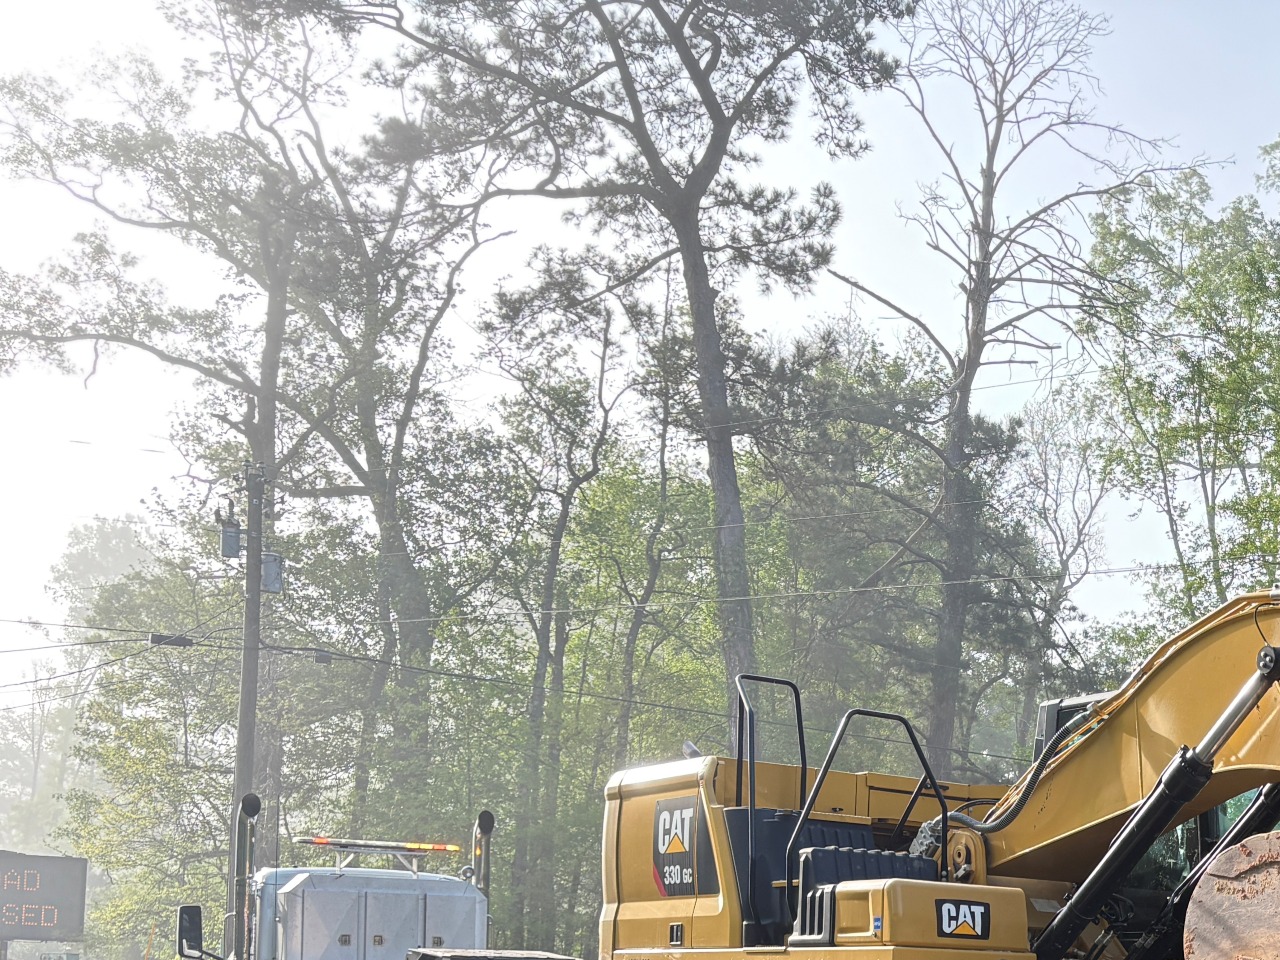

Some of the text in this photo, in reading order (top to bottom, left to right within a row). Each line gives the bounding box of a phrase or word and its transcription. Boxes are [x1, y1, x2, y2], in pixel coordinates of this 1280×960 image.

[658, 808, 694, 855] CAT
[3, 868, 41, 892] AD
[663, 865, 693, 885] 330 GC
[2, 903, 58, 927] SED
[941, 902, 985, 936] CAT
